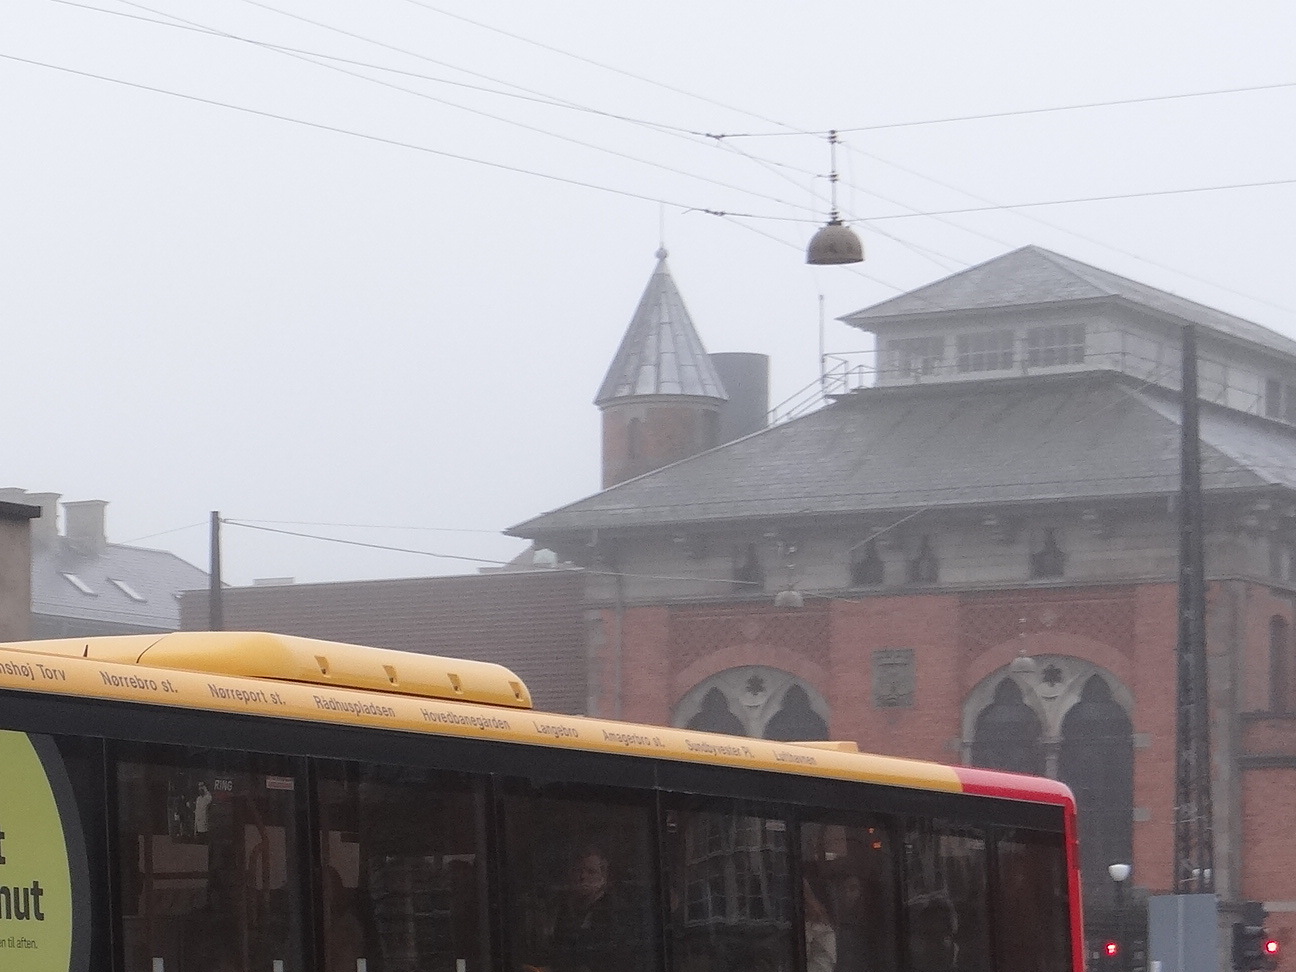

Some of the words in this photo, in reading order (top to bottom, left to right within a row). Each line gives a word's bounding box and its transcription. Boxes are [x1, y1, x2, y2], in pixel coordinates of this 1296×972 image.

[36, 663, 66, 681] Torv
[100, 671, 158, 691] Nørrebro
[161, 680, 179, 693] st.
[207, 683, 268, 704] Nørreport
[270, 692, 286, 705] st.
[313, 695, 396, 718] Rådhuspladsen
[420, 708, 511, 730] Hovedbanegården
[533, 721, 579, 738] Langebro
[602, 729, 651, 746] Amagerbro
[7, 937, 15, 948] til
[16, 937, 38, 949] aften.
